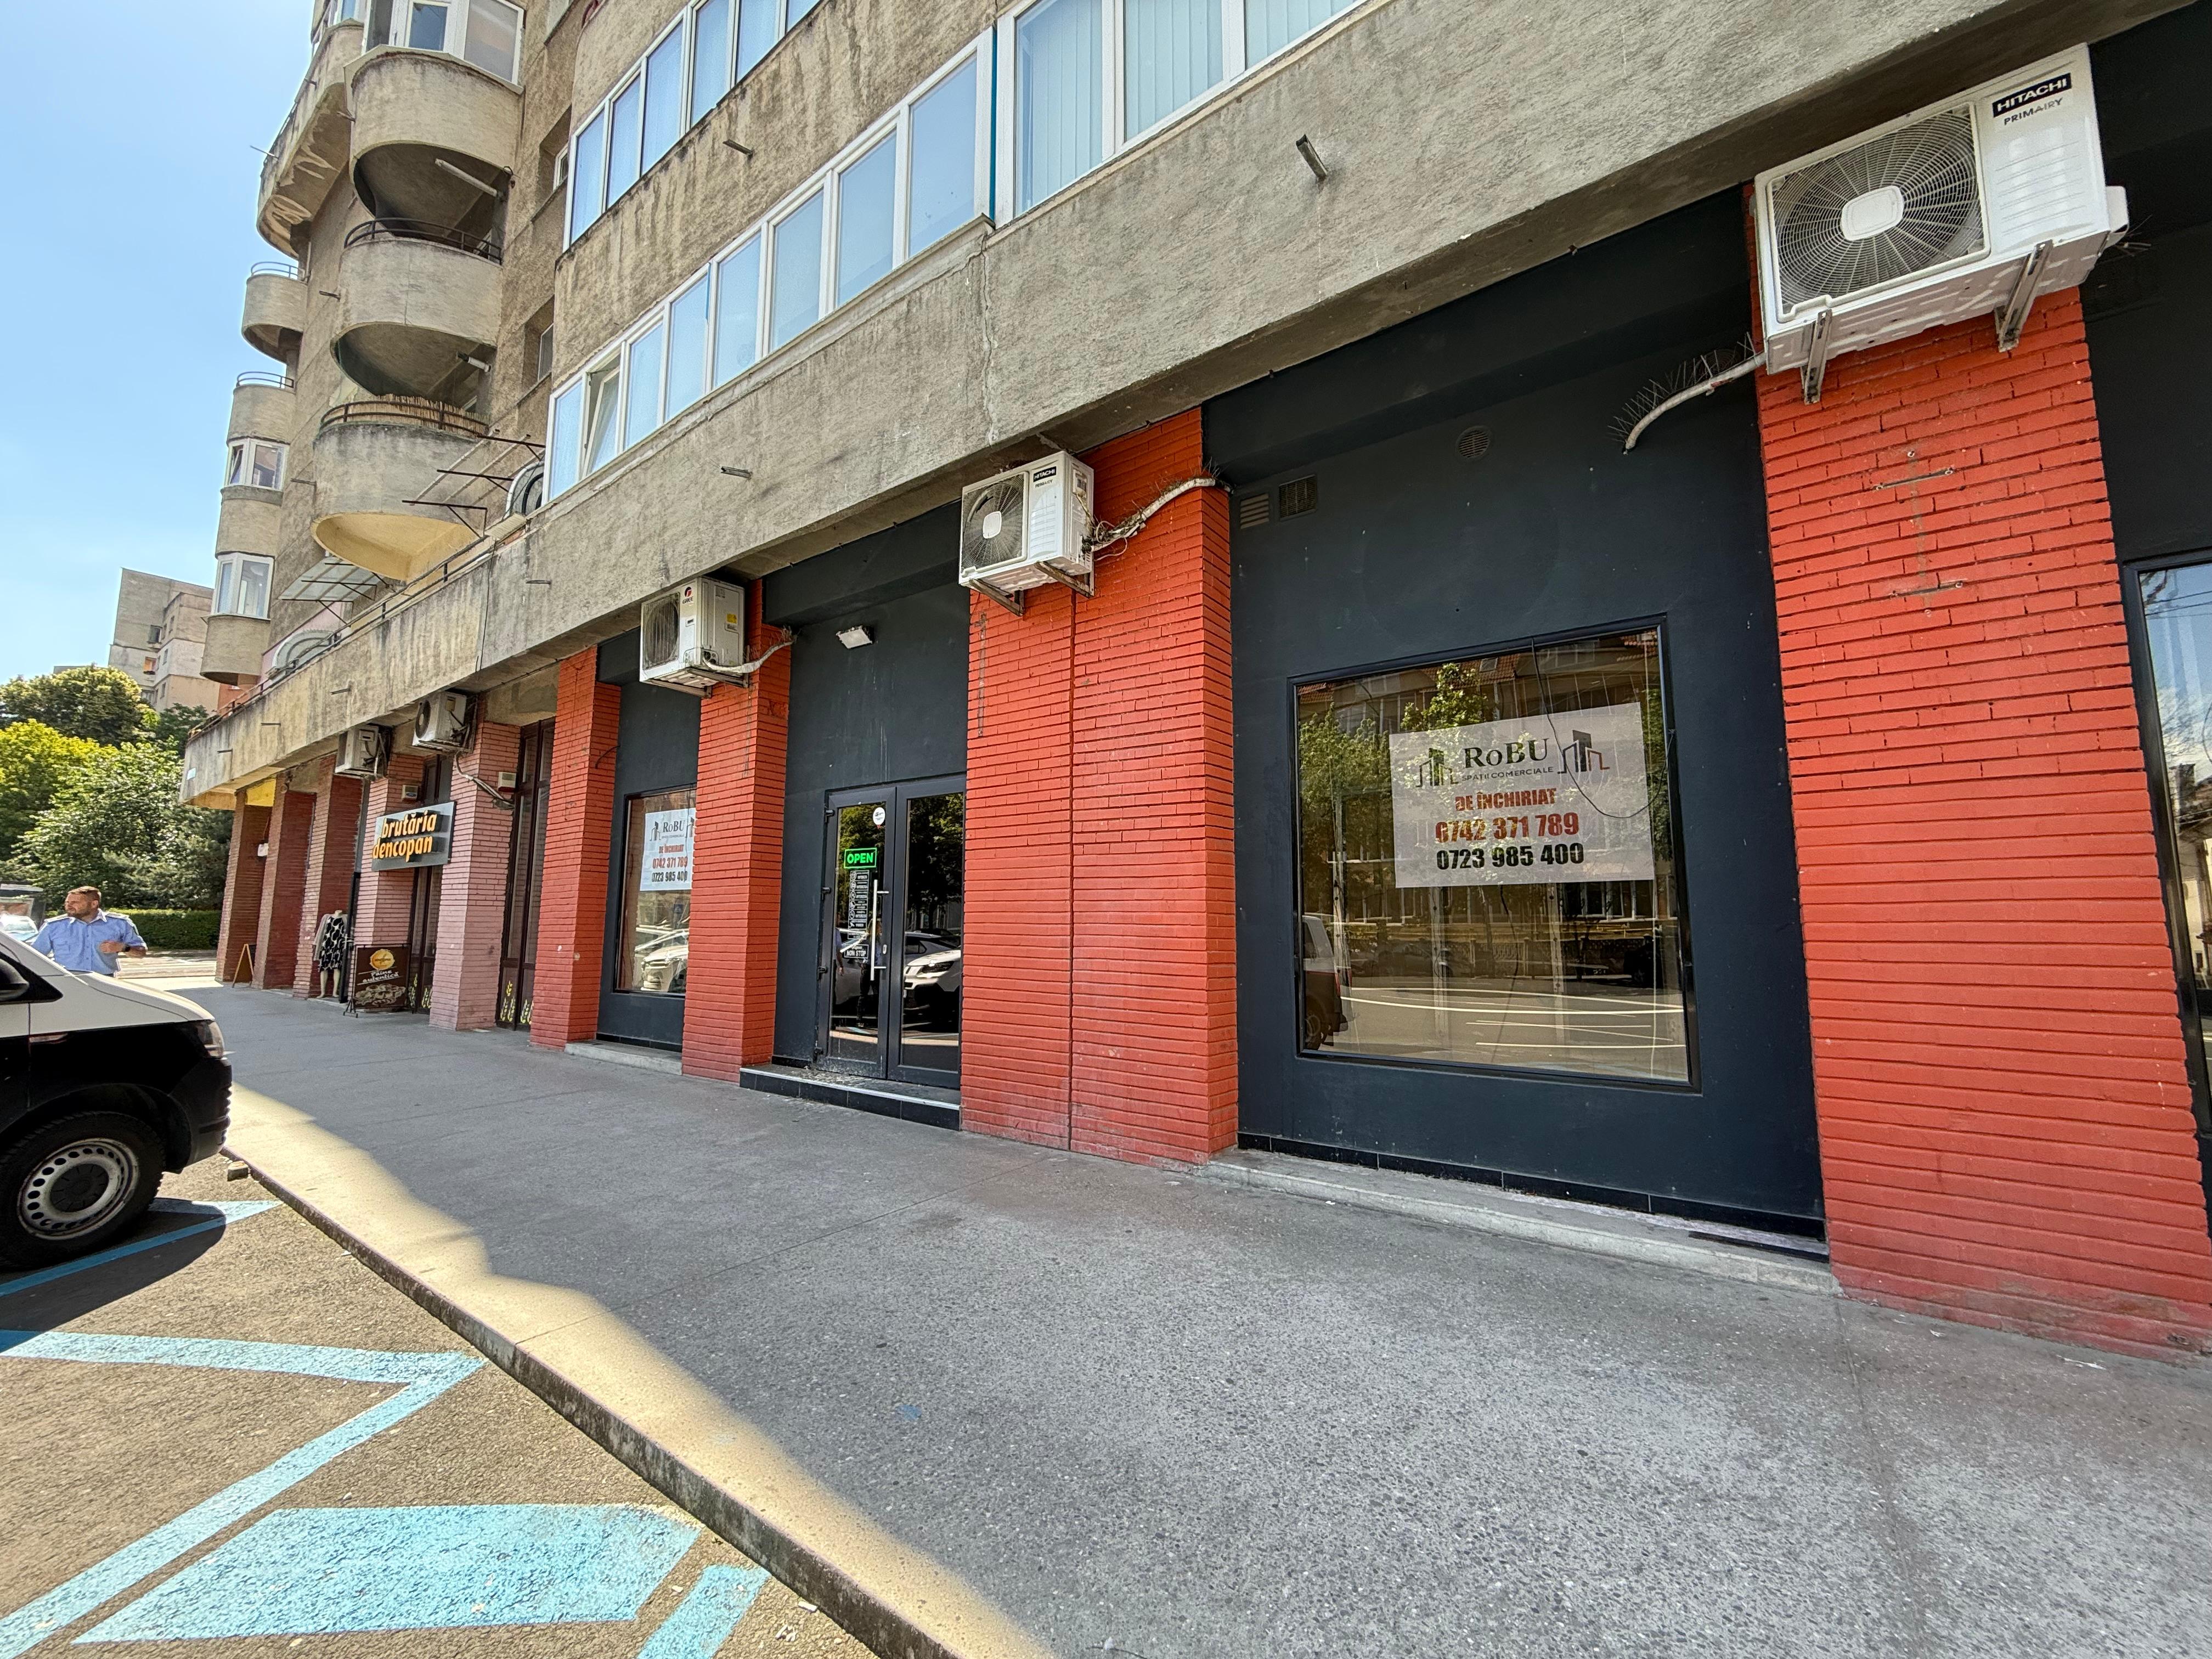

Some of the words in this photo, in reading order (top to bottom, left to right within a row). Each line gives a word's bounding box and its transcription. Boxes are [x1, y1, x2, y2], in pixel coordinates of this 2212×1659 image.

[1996, 78, 2068, 112] HITACHI
[2004, 97, 2063, 126] PRIMAIRY
[1034, 469, 1055, 479] HITACHI
[1464, 738, 1550, 769] RoBU
[1491, 766, 1554, 778] COMERCIALE
[1455, 794, 1474, 811] DE
[1476, 788, 1557, 810] ÎNCHIRIAT
[381, 809, 437, 839] brutăria
[662, 820, 685, 833] RoBU
[1435, 819, 1486, 843] 0742
[1492, 815, 1530, 840] 371
[1535, 812, 1579, 838] 789
[372, 836, 433, 863] dencopan
[847, 852, 874, 864] OPEN
[1436, 848, 1485, 870] 0723
[1492, 845, 1534, 868] 985
[1540, 842, 1584, 865] 400
[653, 857, 665, 869] 0742
[667, 857, 676, 869] 371
[677, 856, 688, 868] 789
[652, 871, 664, 883] 0723
[665, 871, 676, 882] 985
[676, 871, 688, 882] 400
